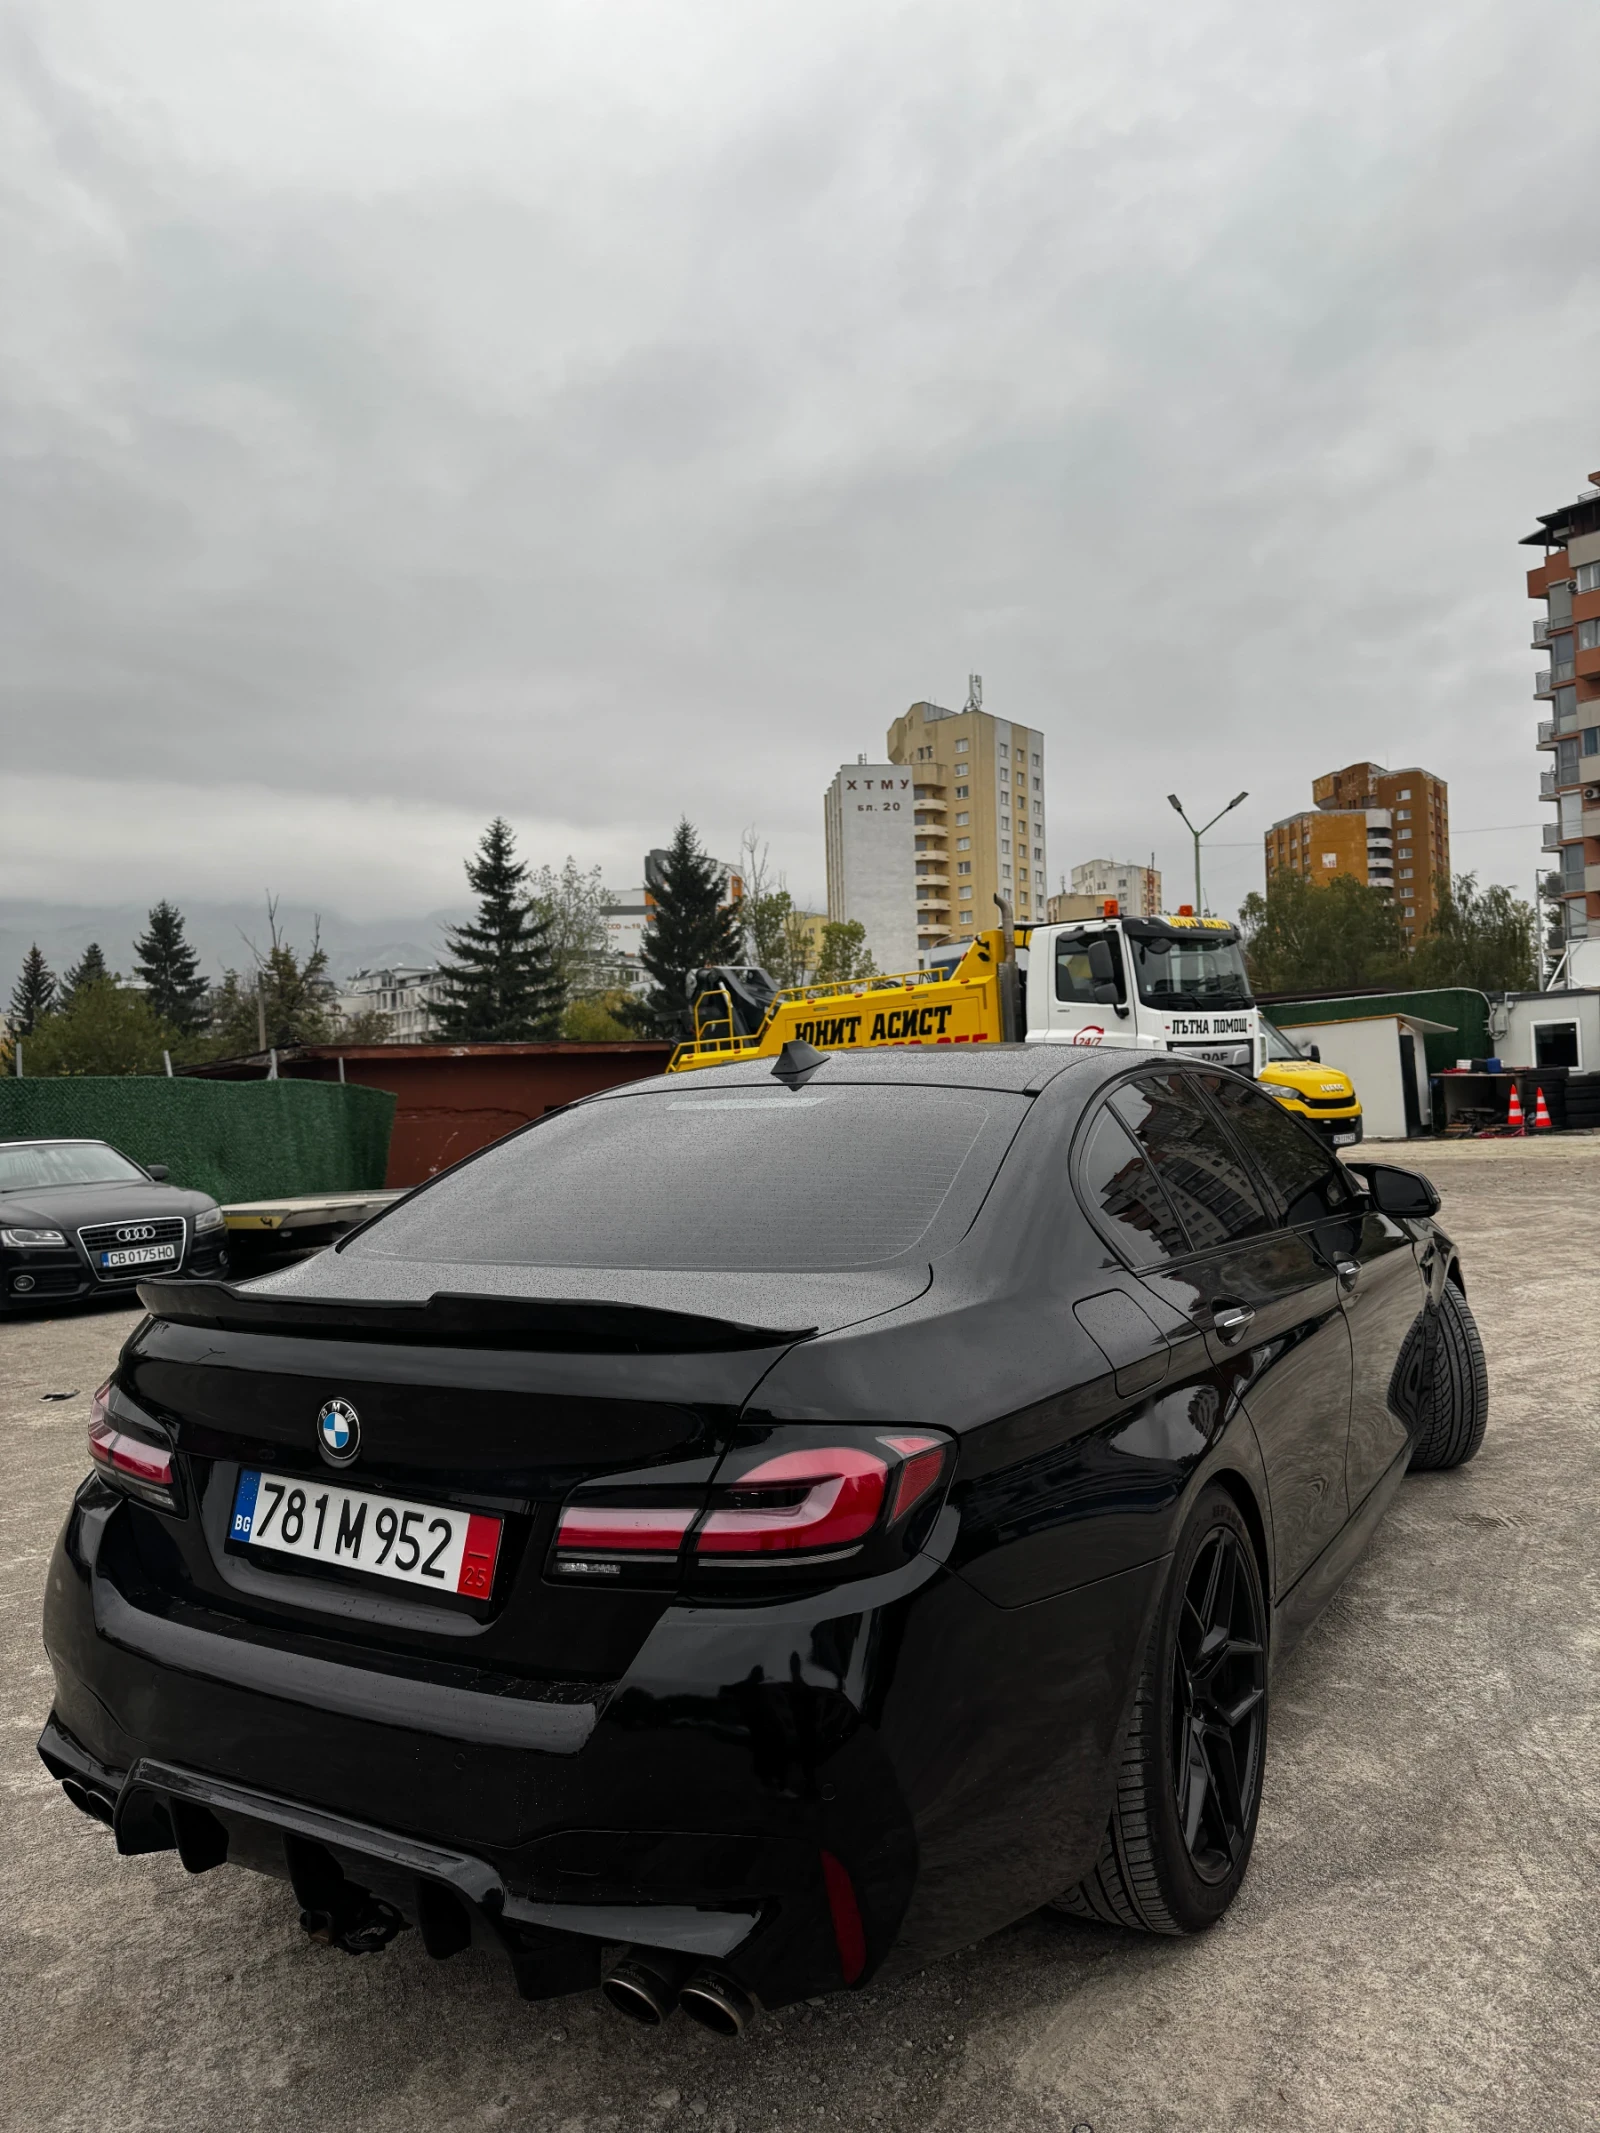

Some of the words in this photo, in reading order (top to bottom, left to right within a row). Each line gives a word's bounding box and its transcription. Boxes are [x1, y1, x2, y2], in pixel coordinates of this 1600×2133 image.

[846, 779, 910, 791] ХТМУ
[883, 802, 901, 812] 20
[795, 1016, 861, 1047] ЮНИТ
[870, 1005, 952, 1041] АСИСТ
[1172, 1019, 1210, 1034] ПЪТНА
[1213, 1018, 1248, 1033] ПОМОЩ
[1079, 1037, 1102, 1046] 24/7
[1201, 1052, 1229, 1061] DAF
[110, 1252, 127, 1265] CB
[128, 1248, 156, 1263] 0175
[319, 1401, 356, 1423] BMW
[234, 1513, 251, 1533] BG
[463, 1565, 487, 1588] 25
